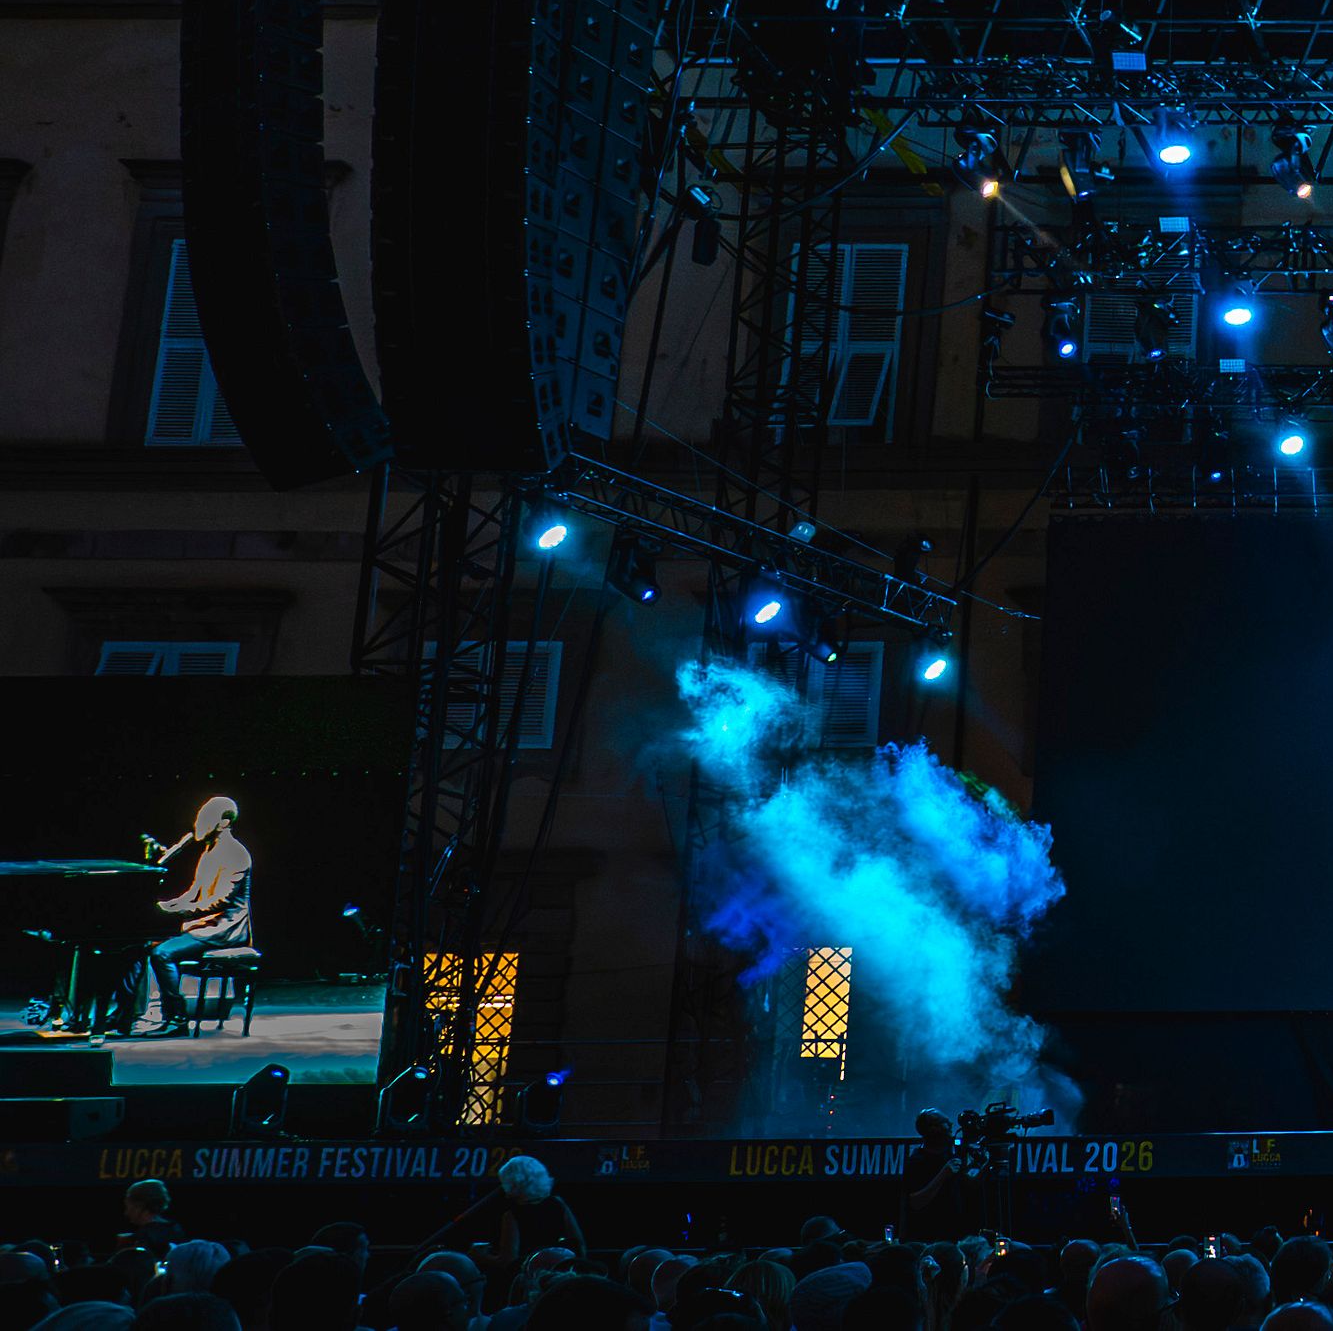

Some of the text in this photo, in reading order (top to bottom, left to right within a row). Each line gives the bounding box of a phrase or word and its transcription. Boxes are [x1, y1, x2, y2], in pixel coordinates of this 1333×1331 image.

[97, 1146, 523, 1179] LUCCA SUMMER FESTIVAL 202
[729, 1141, 1153, 1177] LUCCA SUMM IVAL 2026
